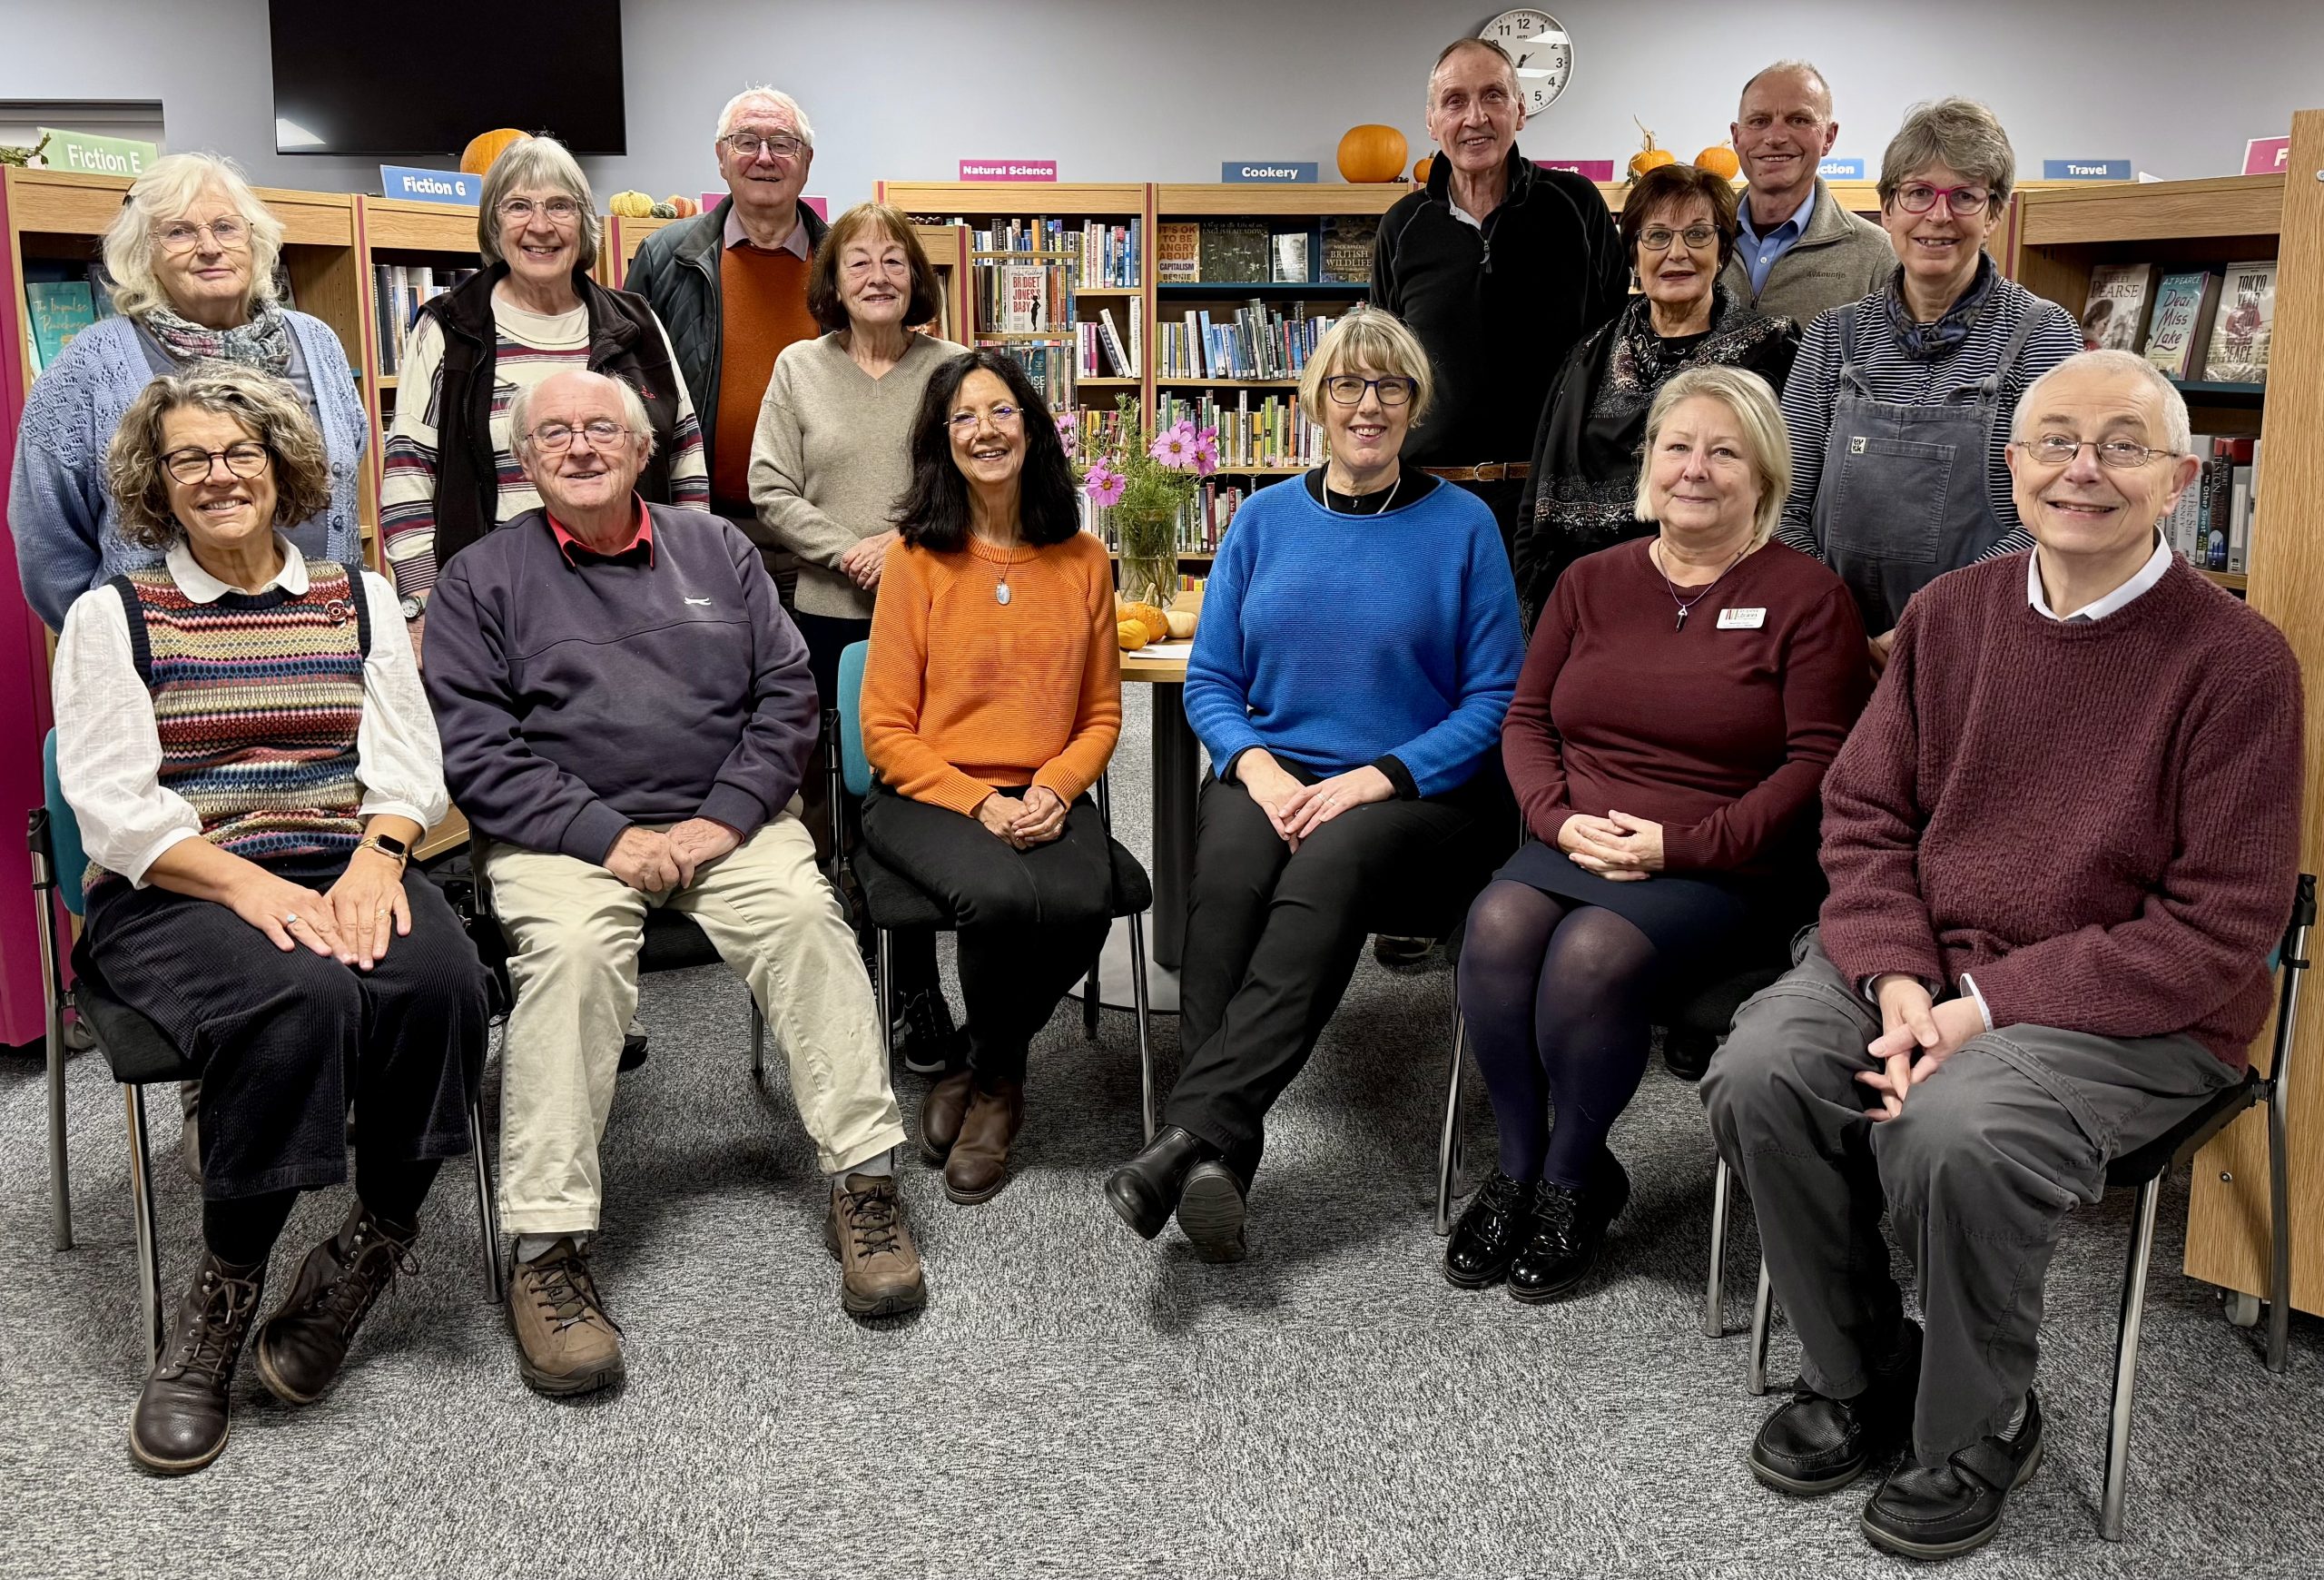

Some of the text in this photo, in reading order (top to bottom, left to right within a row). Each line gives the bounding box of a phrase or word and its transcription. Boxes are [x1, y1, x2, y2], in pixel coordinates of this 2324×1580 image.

[1516, 18, 1531, 29] 12
[1540, 24, 1545, 34] 1
[1498, 25, 1511, 35] 11
[1556, 58, 1563, 68] 3
[1548, 77, 1556, 87] 4
[1534, 91, 1541, 101] 5
[67, 143, 143, 174] Fiction E
[962, 165, 1053, 175] Natural Science
[1242, 167, 1298, 180] Cookery
[1816, 163, 1855, 174] ction
[2067, 164, 2107, 176] Travel
[403, 176, 465, 196] Fiction G
[1159, 243, 1195, 252] ANGRY
[1326, 259, 1372, 267] WILDLIFE
[1013, 276, 1040, 288] BRIDGET
[2175, 276, 2201, 284] PEARCE
[2237, 274, 2267, 292] TOKYO
[1013, 289, 1040, 300] JONES'S
[2090, 281, 2139, 298] PEARSE
[2163, 289, 2193, 308] Dear
[2237, 292, 2260, 309] YEAR
[1013, 301, 1030, 312] BABY
[2157, 309, 2188, 331] Miss
[2152, 328, 2182, 351] Lake
[2224, 345, 2253, 363] PEACE
[2212, 457, 2222, 493] PESTON
[2187, 501, 2196, 518] Pole
[2185, 520, 2196, 537] Star
